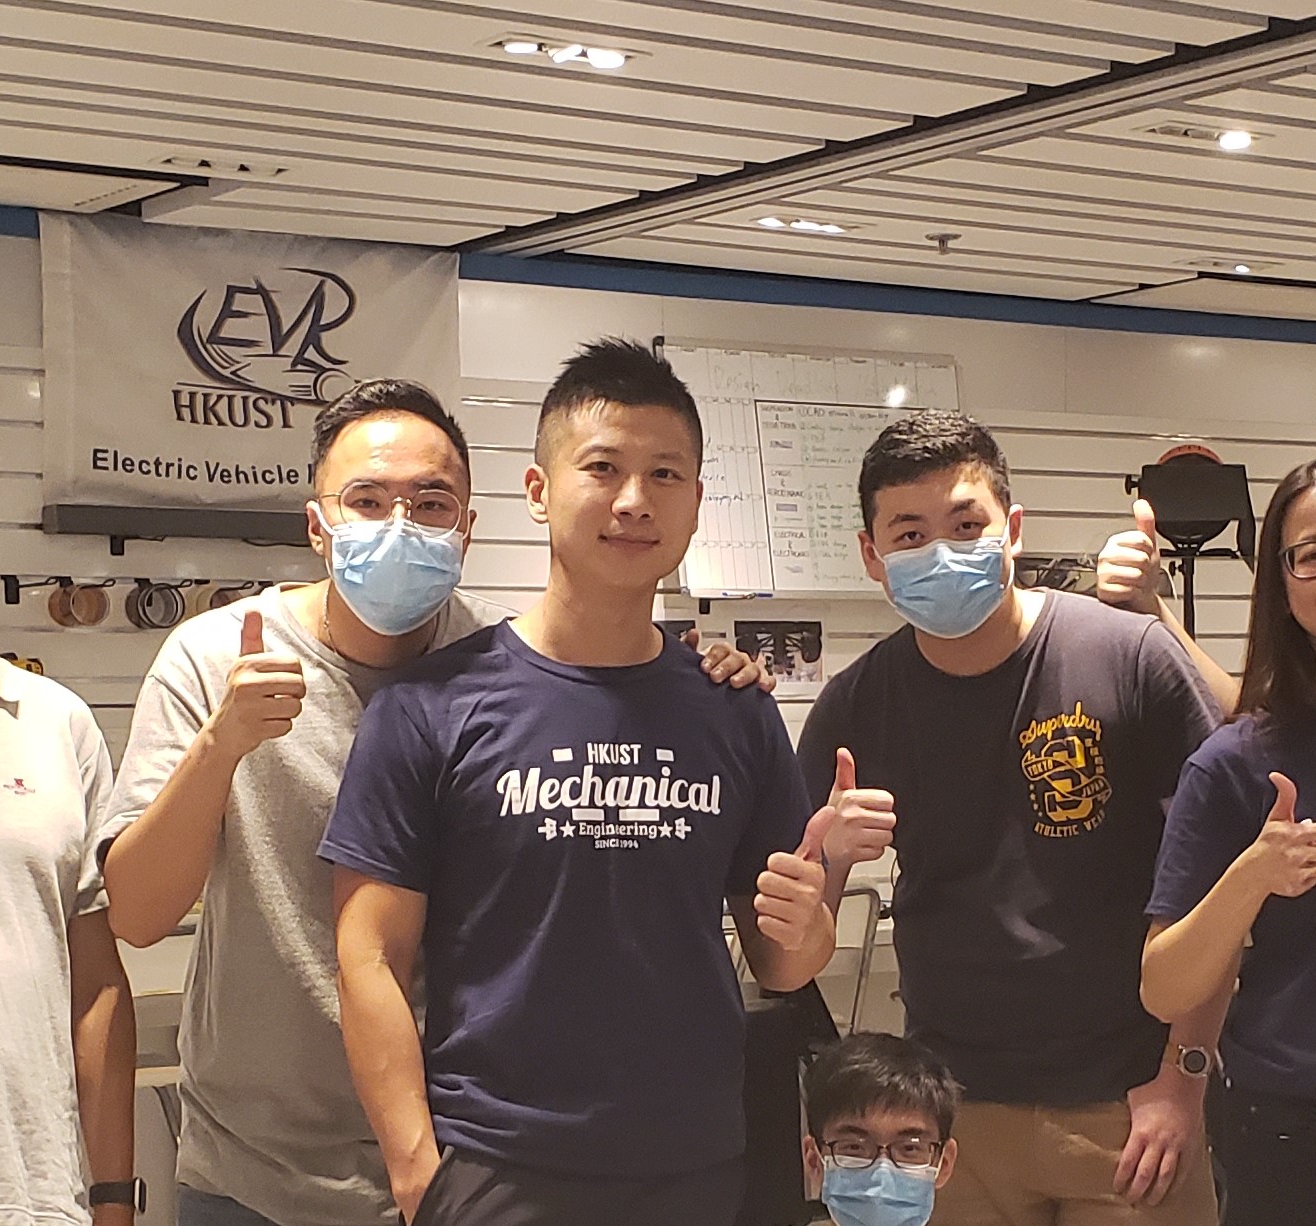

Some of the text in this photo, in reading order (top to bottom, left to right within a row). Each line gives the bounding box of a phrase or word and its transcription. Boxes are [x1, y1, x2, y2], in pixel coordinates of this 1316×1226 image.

[172, 388, 295, 430] HKUST
[92, 447, 199, 483] Electric
[205, 459, 300, 486] Vehicle
[1019, 701, 1102, 749] Superdry
[587, 742, 641, 765] HKUST
[496, 764, 721, 817] Mechanical
